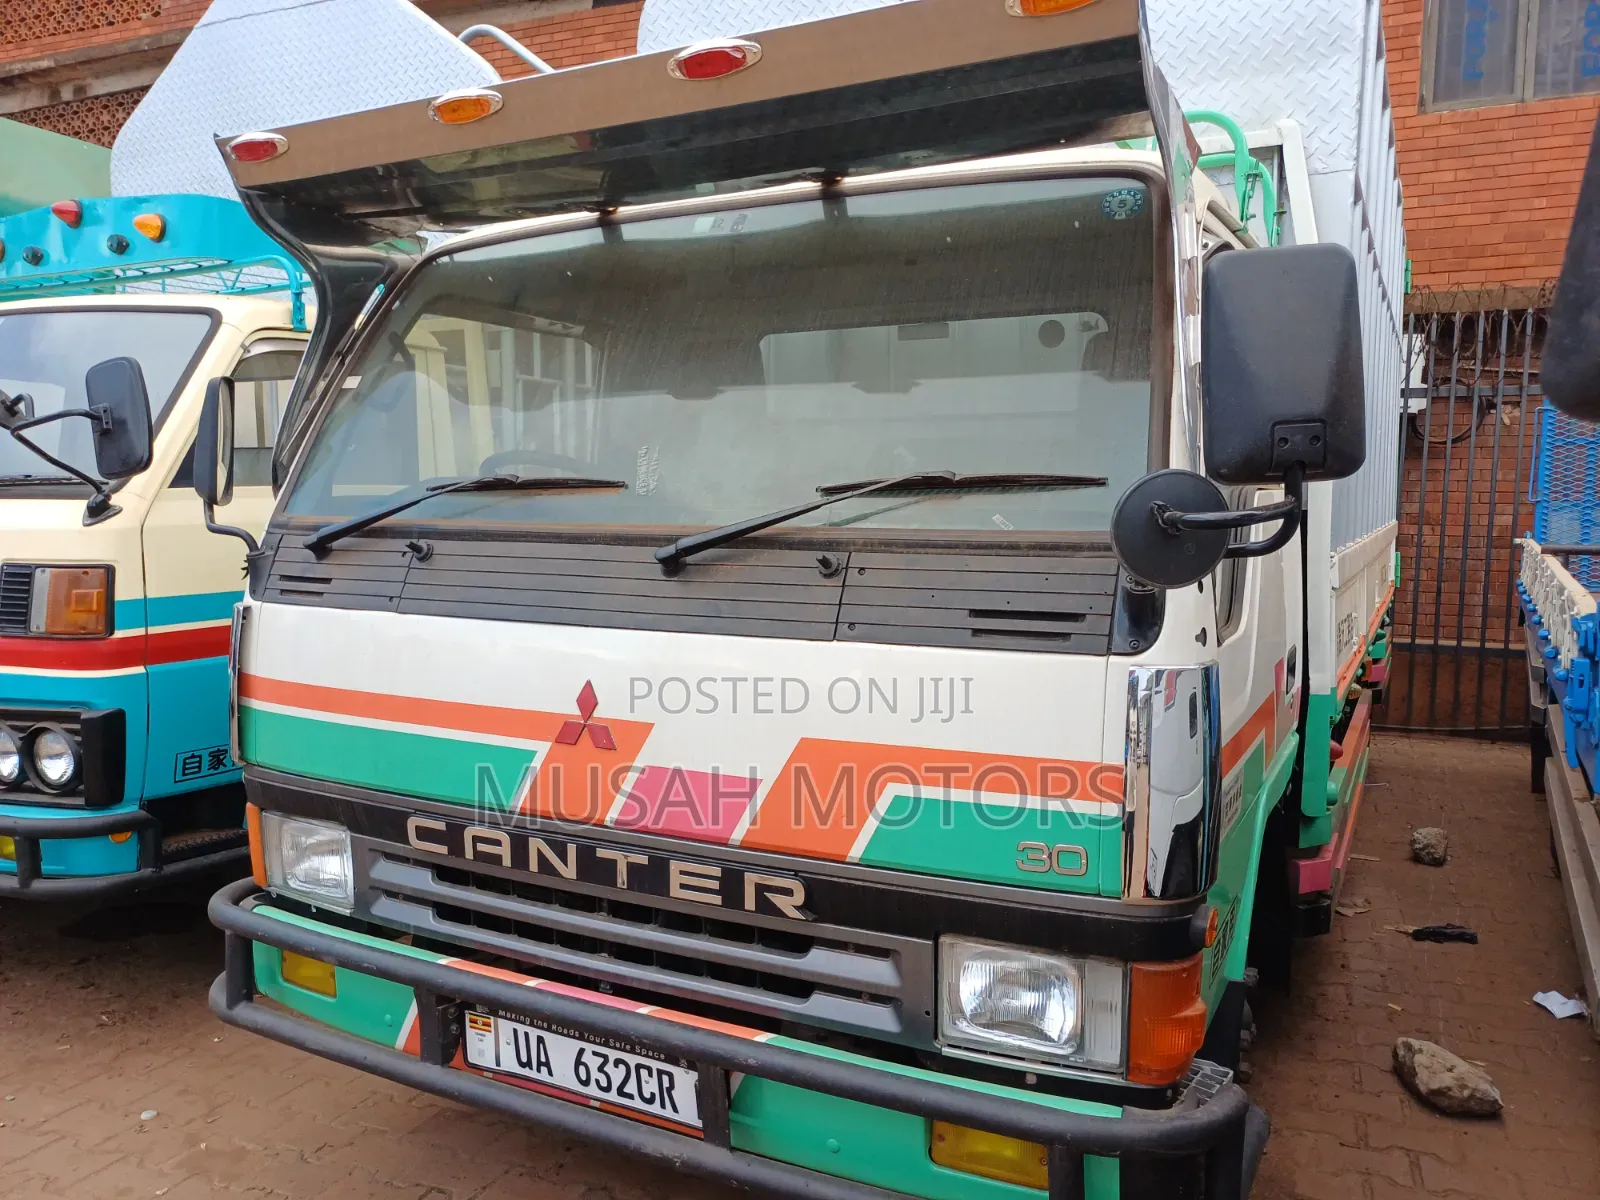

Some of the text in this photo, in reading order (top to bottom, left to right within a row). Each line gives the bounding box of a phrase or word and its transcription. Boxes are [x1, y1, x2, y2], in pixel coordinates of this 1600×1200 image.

[1117, 199, 1128, 208] 5
[182, 748, 236, 777] 自家
[406, 816, 808, 921] CANTER
[1015, 841, 1088, 877] 30
[498, 1009, 666, 1060] Making the Roads Your Safe Space
[512, 1027, 680, 1114] UA 632CR
